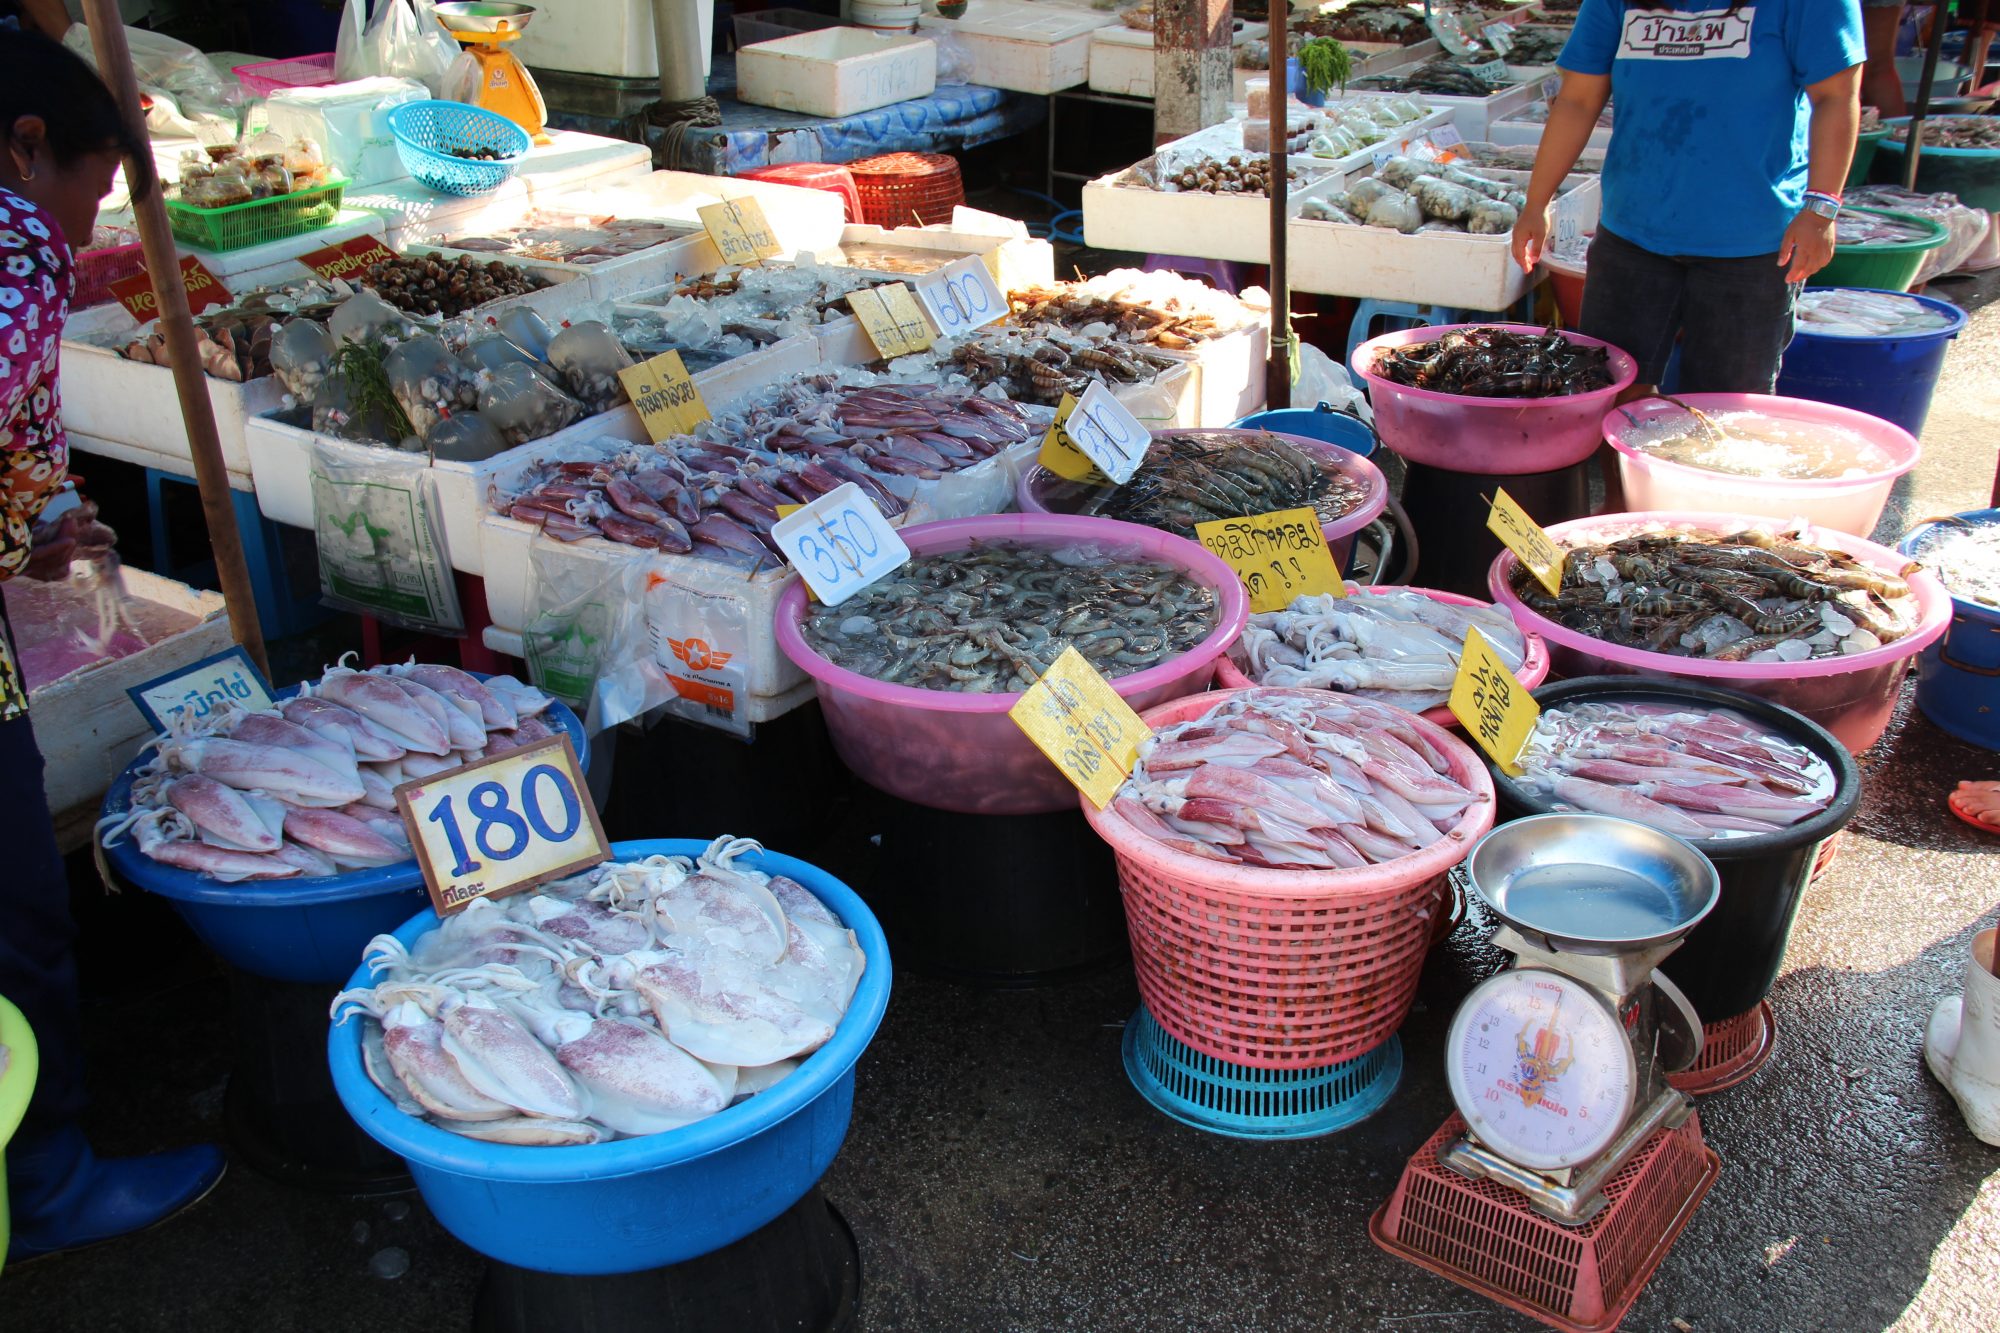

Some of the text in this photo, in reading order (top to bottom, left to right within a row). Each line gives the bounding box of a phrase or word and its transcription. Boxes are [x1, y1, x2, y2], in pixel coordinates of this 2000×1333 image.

[1659, 46, 1700, 55] ประเทศไทย
[316, 244, 391, 278] หอยหวาน
[930, 273, 989, 326] 600
[635, 373, 696, 419] หมึกกล้วย
[798, 508, 878, 583] 350
[1206, 520, 1320, 559] หมึกหอม
[429, 763, 581, 878] 180
[1489, 1015, 1500, 1027] 13
[1478, 1036, 1490, 1049] 12
[1477, 1063, 1487, 1074] 11
[1484, 1087, 1500, 1102] 10
[1579, 1106, 1588, 1118] 5
